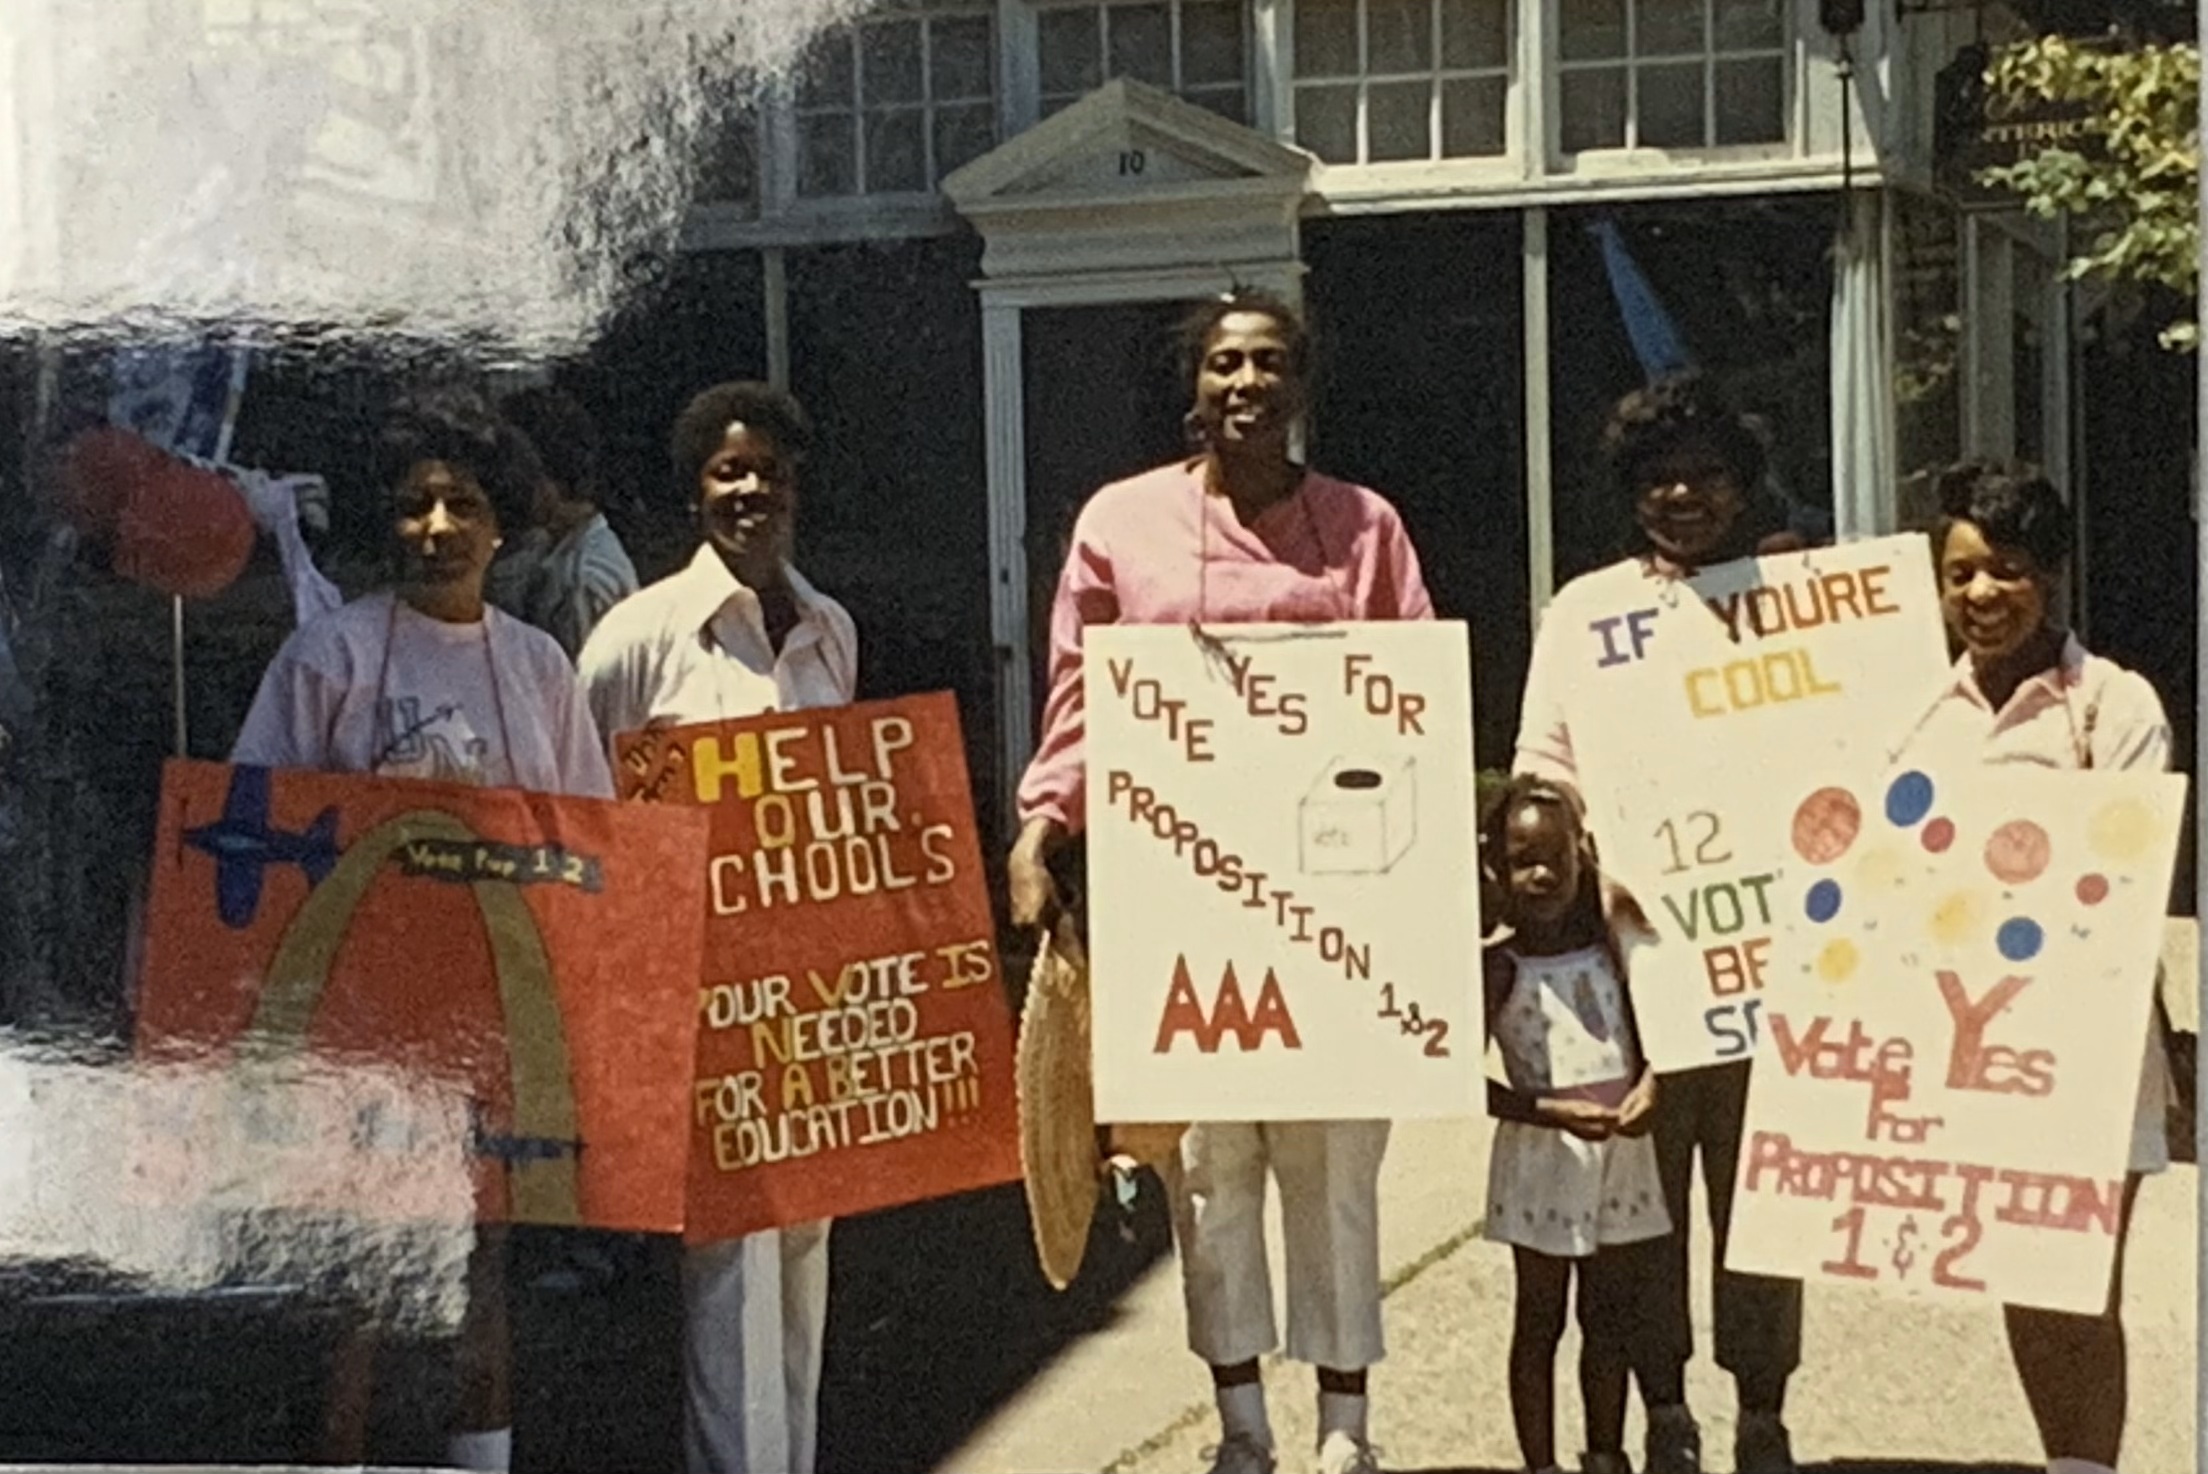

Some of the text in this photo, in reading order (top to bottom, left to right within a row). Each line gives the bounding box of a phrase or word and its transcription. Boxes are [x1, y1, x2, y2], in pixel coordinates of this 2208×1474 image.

[1120, 149, 1145, 176] 10
[1588, 607, 1660, 668] IF
[1107, 654, 1426, 762] VOTE YES FOR
[1684, 647, 1843, 719] COOL
[692, 716, 914, 803] HELP
[1108, 770, 1371, 980] PROPOSITION
[1661, 872, 1774, 941] VOT
[806, 952, 930, 1008] VOTE
[936, 939, 992, 990] IS
[1152, 952, 1303, 1054] AAA
[752, 997, 918, 1070] NEEDED
[1767, 969, 2057, 1096] Vote Yes
[695, 1031, 980, 1127] FOR A BETTER
[1865, 1077, 1945, 1143] For
[1745, 1130, 2124, 1235] PROPOSITION
